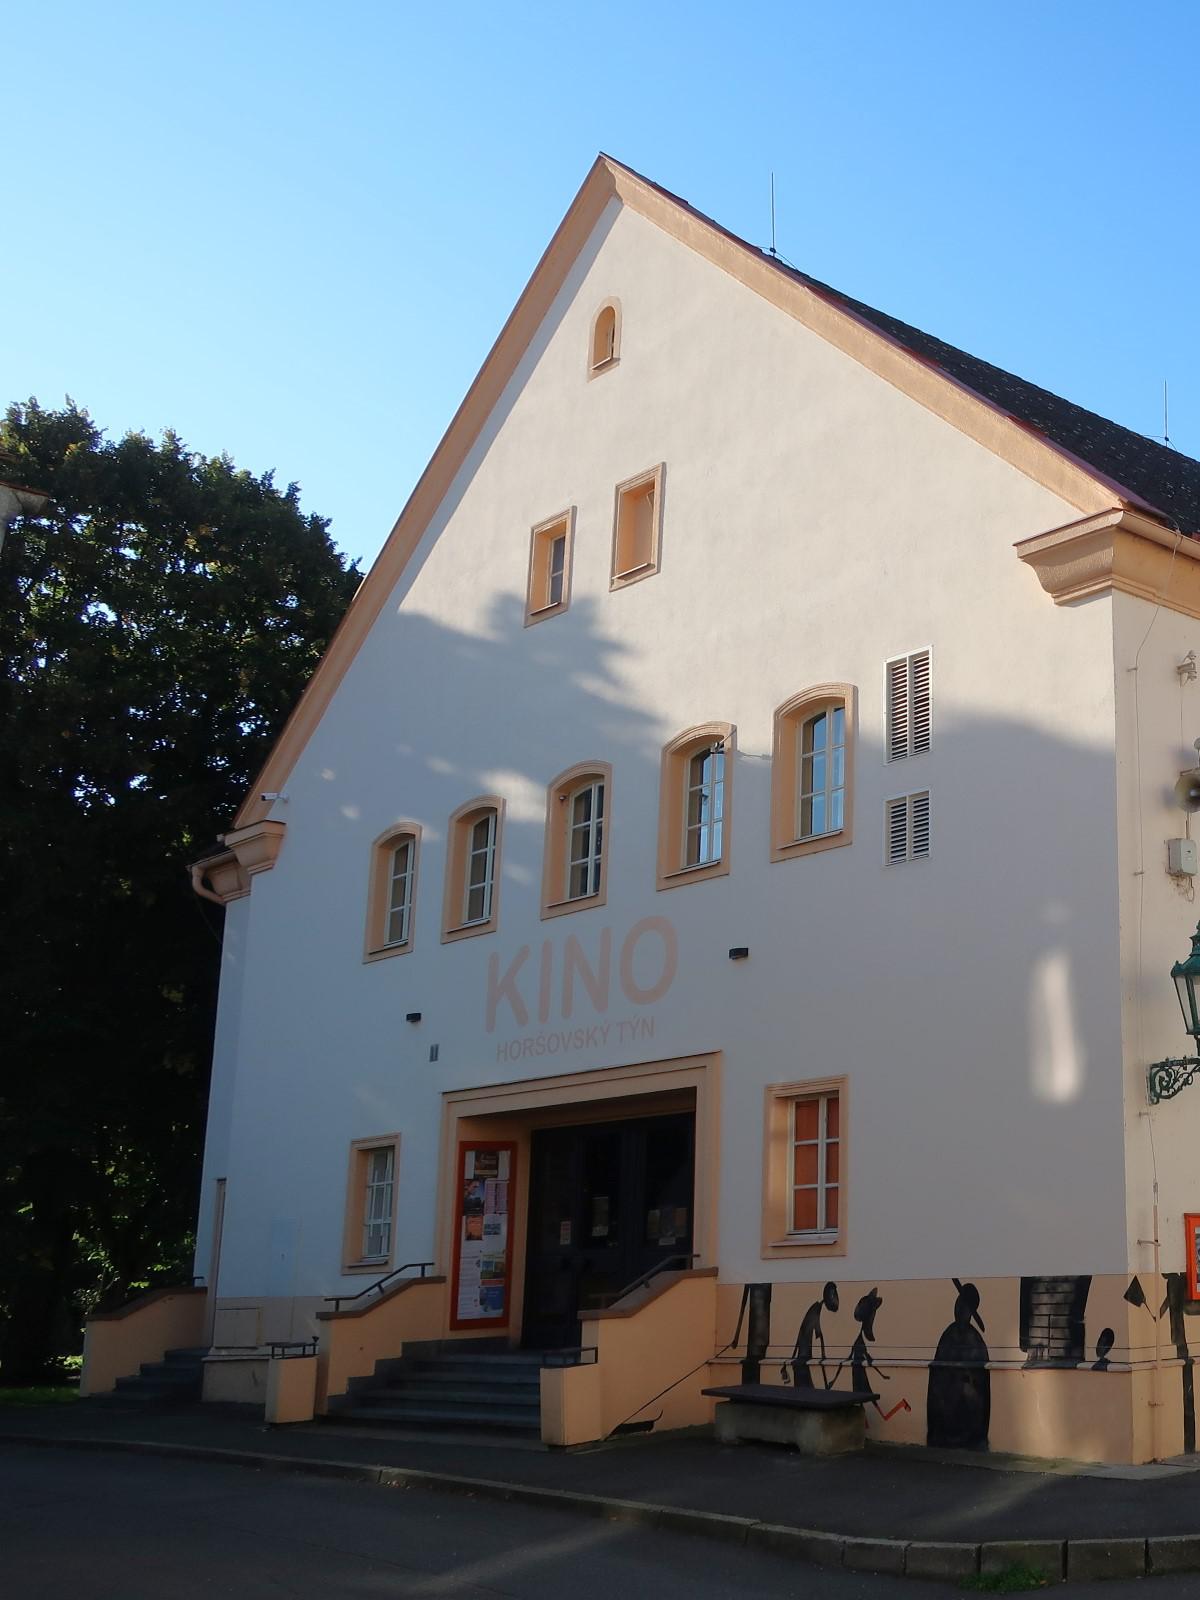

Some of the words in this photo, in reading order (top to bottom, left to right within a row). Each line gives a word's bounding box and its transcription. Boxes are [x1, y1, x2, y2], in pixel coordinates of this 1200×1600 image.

[484, 916, 678, 1033] KINO
[496, 1021, 610, 1063] HORŠOVSKÝ
[617, 1014, 655, 1044] TÝN
